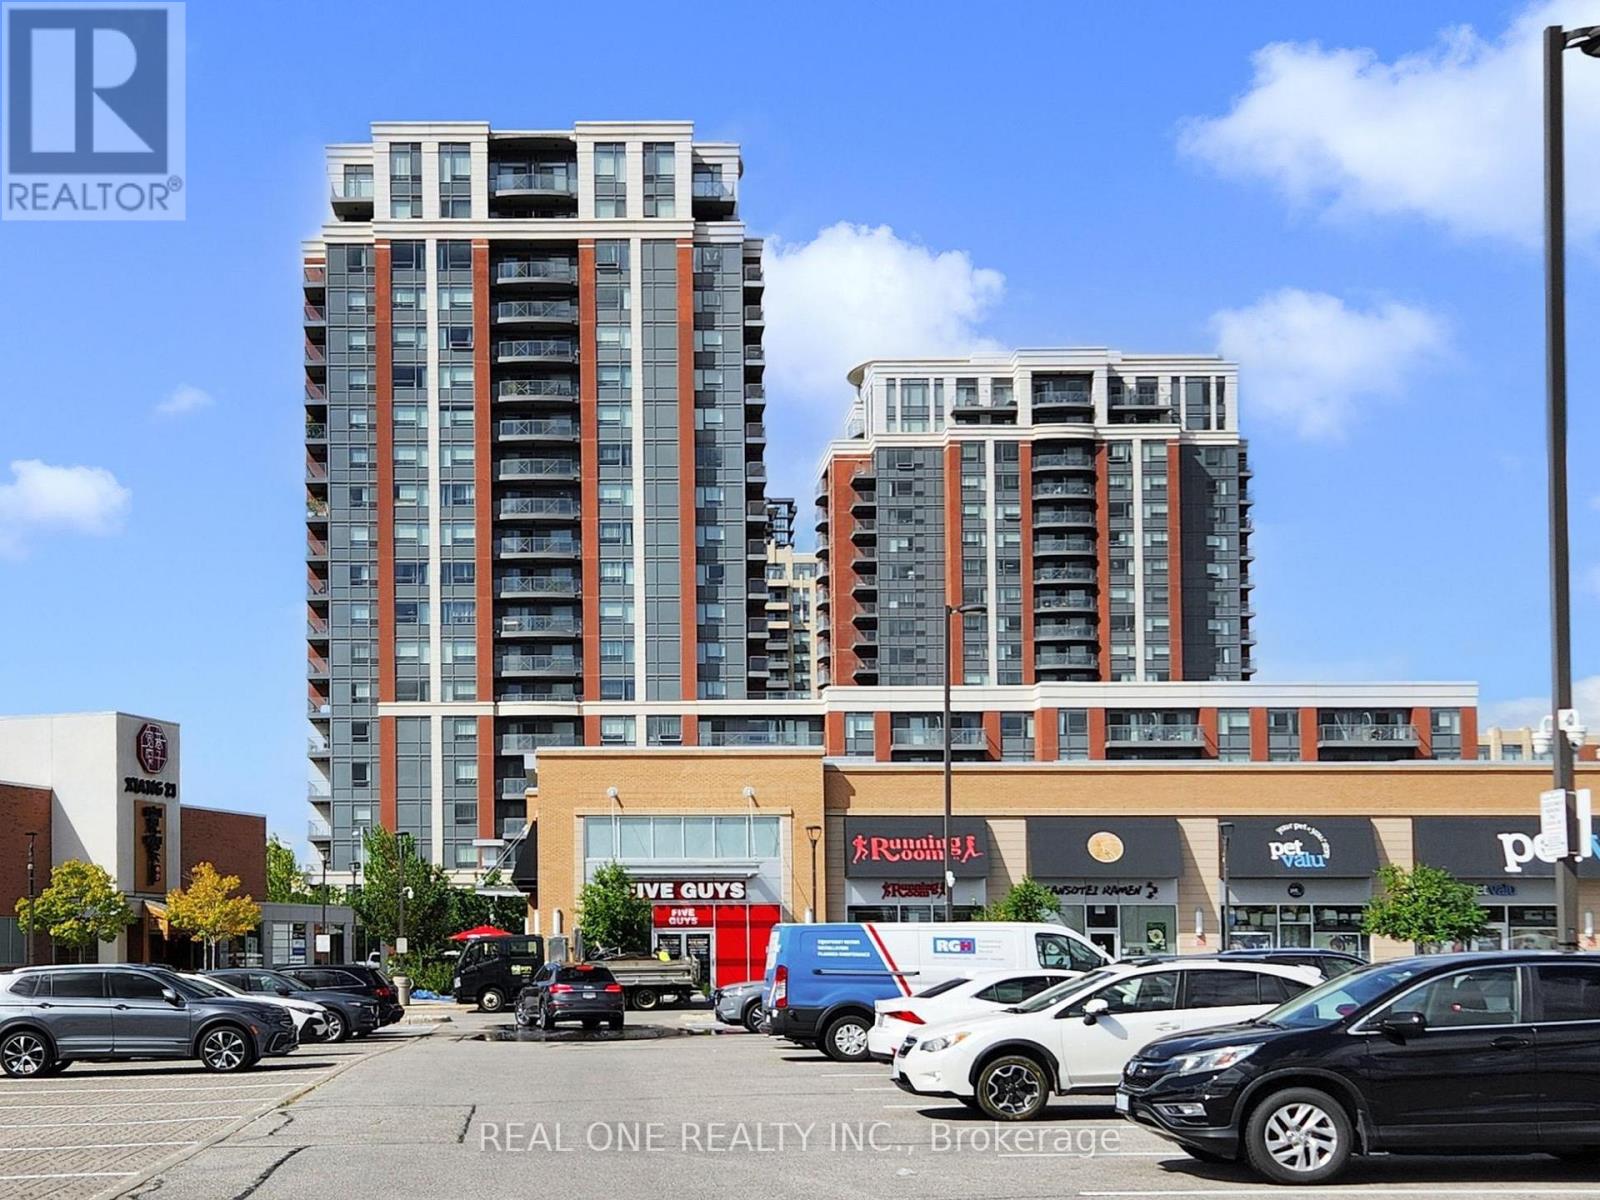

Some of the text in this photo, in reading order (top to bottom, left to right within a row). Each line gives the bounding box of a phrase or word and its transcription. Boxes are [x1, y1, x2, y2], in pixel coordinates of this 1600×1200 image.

[1267, 839, 1304, 860] pet
[1279, 851, 1327, 868] valu
[679, 881, 745, 899] GUYS
[1046, 884, 1142, 896] ANSOTEI RAMEN
[1475, 884, 1489, 897] et
[670, 908, 696, 917] FIVE
[668, 916, 698, 925] GUYS
